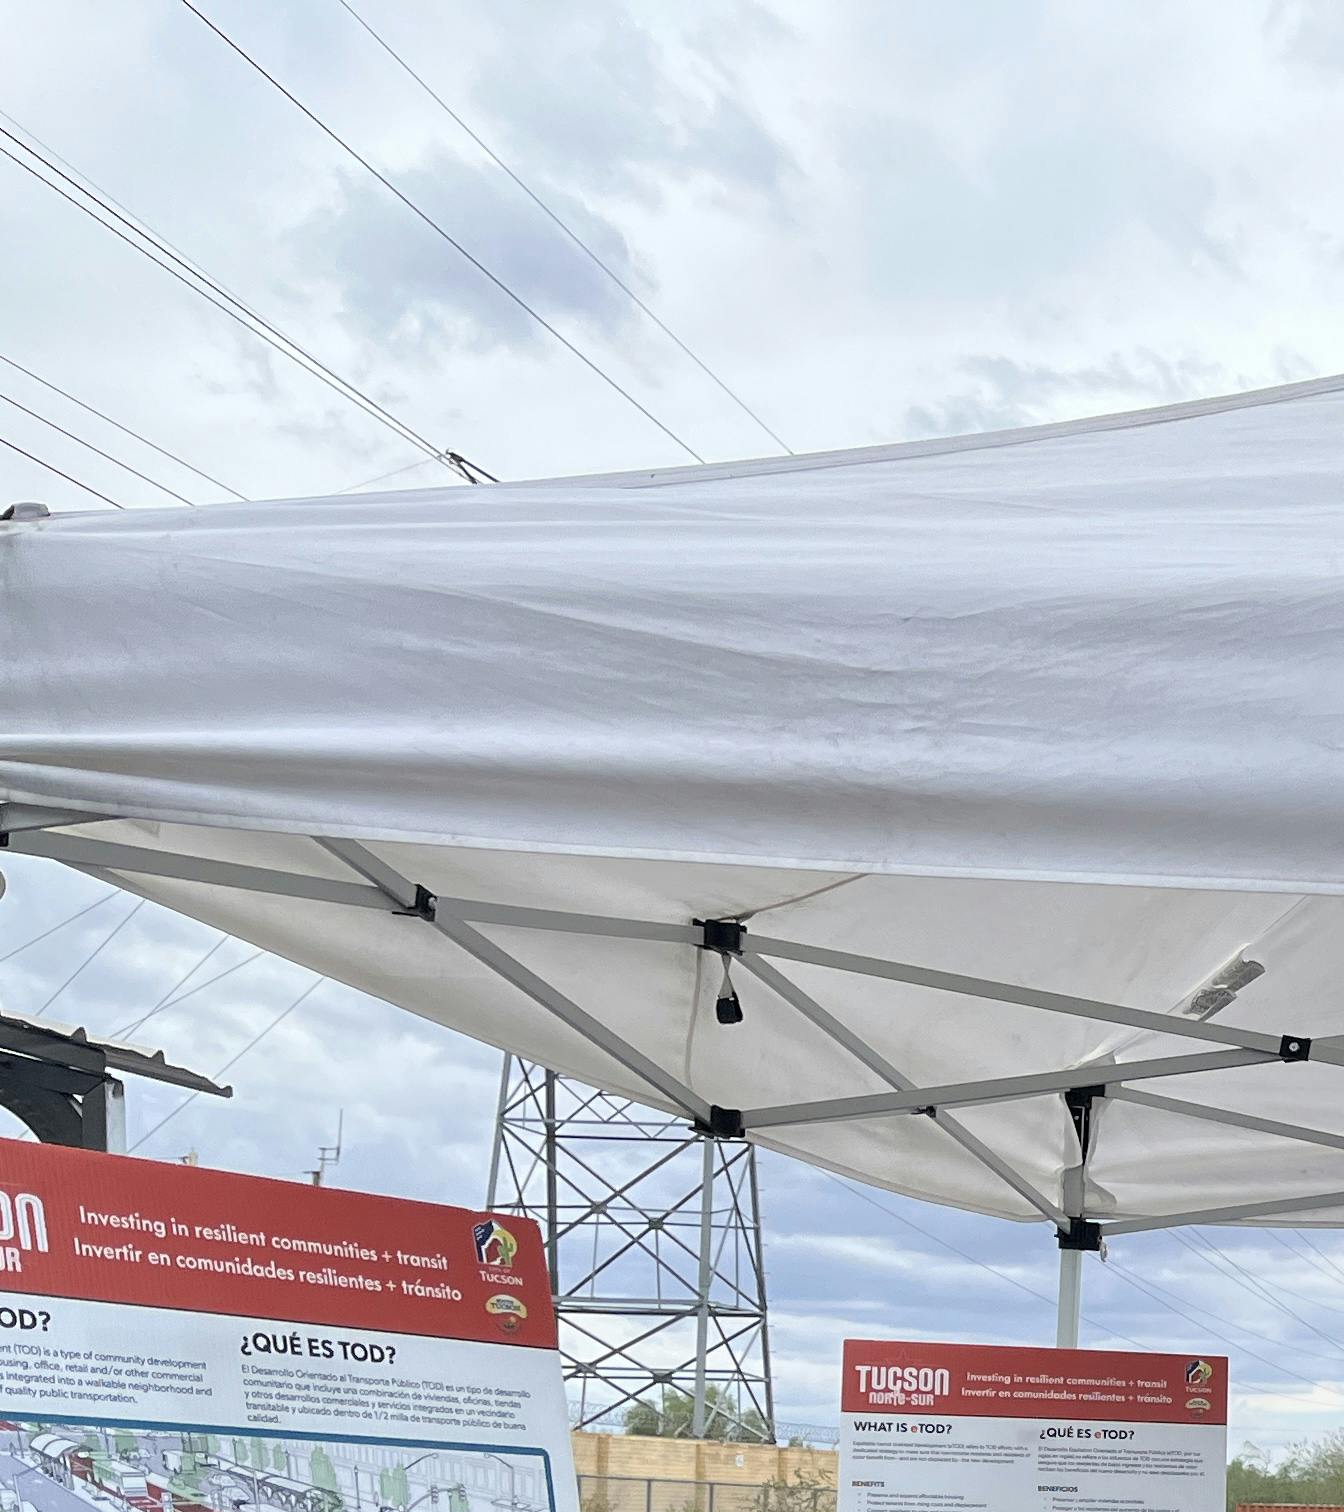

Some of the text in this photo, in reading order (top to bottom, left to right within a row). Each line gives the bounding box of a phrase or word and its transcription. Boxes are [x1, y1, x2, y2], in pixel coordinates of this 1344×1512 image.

[78, 1205, 447, 1269] Investing in resilient communities + transit
[73, 1237, 462, 1300] Invertir en comunidades resilientes + tránsito
[240, 1331, 396, 1364] ¿QUÉ ES TOD?
[855, 1365, 950, 1396] TUCSON
[966, 1371, 1011, 1384] Investing
[1013, 1373, 1023, 1382] in
[1024, 1374, 1064, 1384] resilient
[1065, 1377, 1126, 1386] communities
[1136, 1379, 1167, 1388] transit
